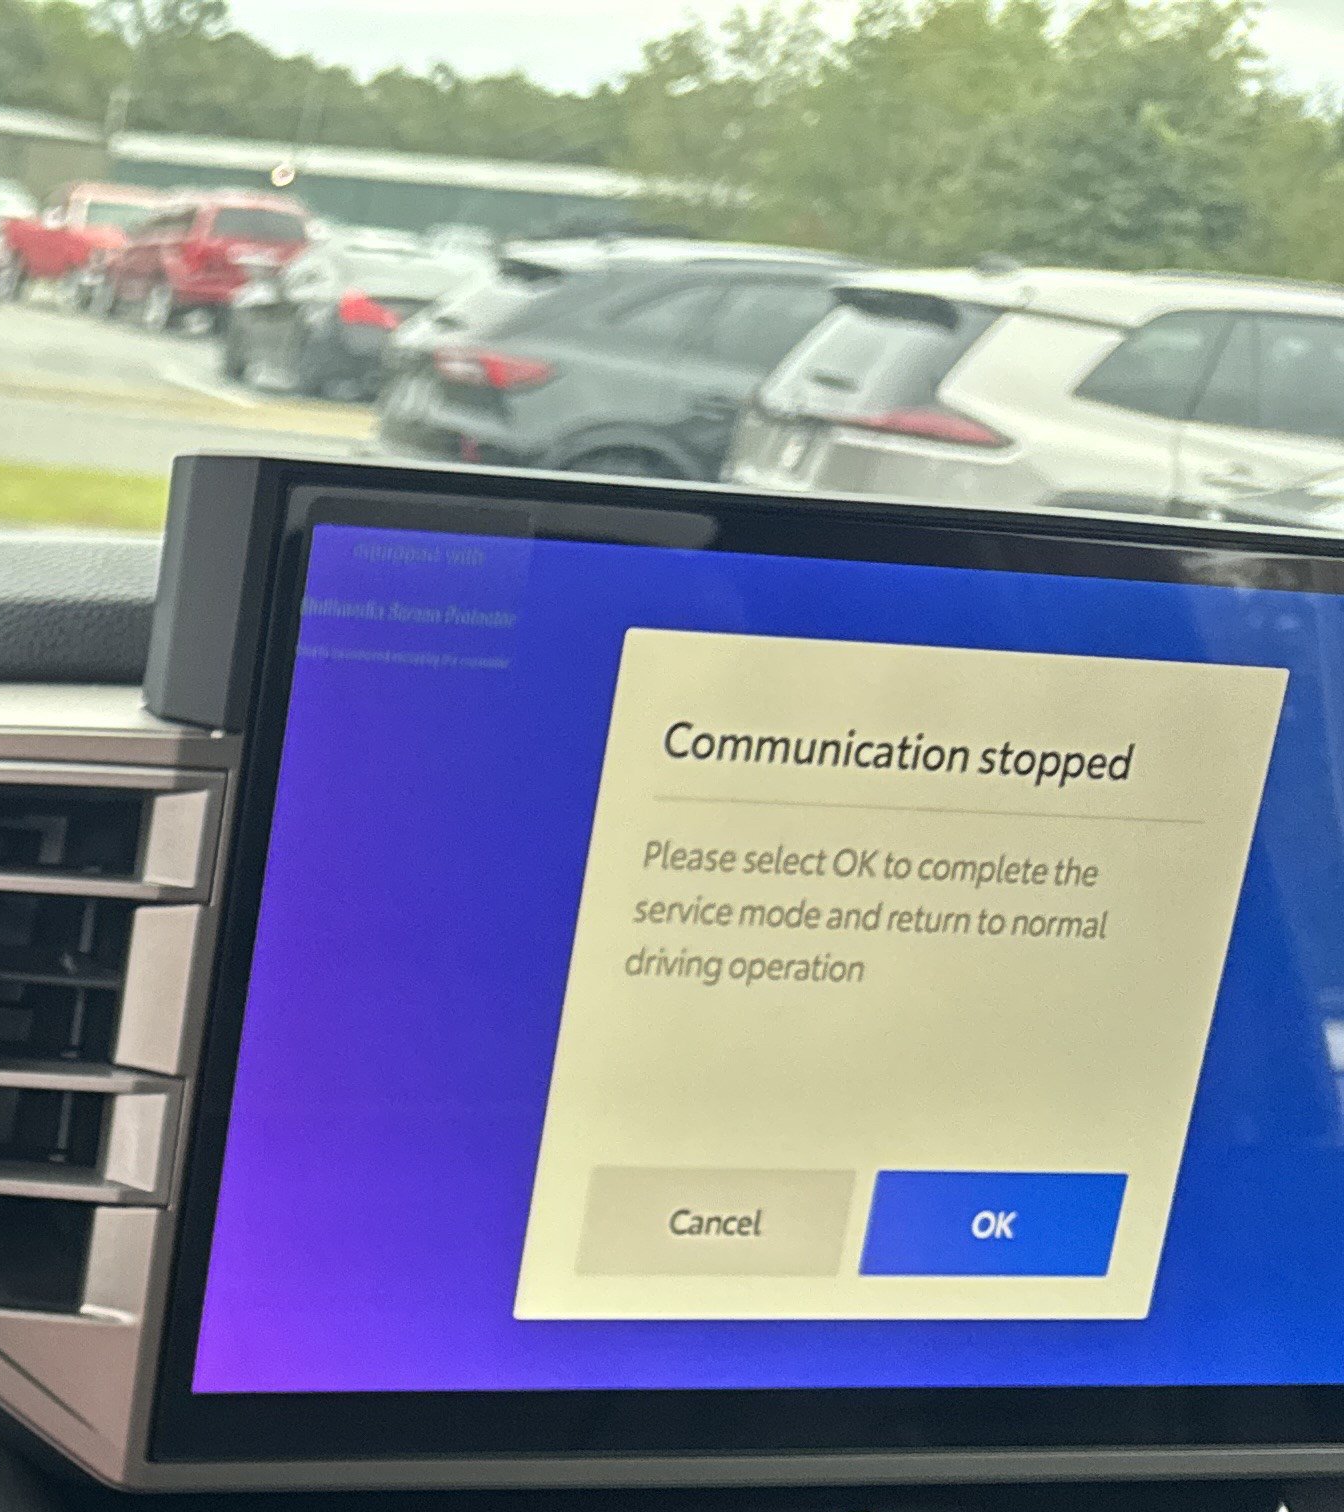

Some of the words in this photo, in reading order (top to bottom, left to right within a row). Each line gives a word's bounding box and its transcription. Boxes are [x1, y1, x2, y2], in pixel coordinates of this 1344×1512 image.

[664, 720, 970, 774] Communication
[977, 741, 1135, 788] stopped
[643, 840, 737, 873] Please
[742, 844, 827, 877] select
[831, 848, 878, 879] OK
[883, 852, 912, 881] to
[917, 853, 1049, 889] complete
[1053, 856, 1100, 887] the
[633, 895, 734, 927] service
[739, 897, 821, 929] mode
[825, 901, 883, 931] and
[887, 905, 970, 935] return
[977, 909, 1007, 936] to
[1011, 910, 1108, 940] normal
[625, 947, 723, 986] driving
[728, 953, 865, 987] operation
[669, 1208, 763, 1238] Cancel
[970, 1210, 1017, 1241] OK
